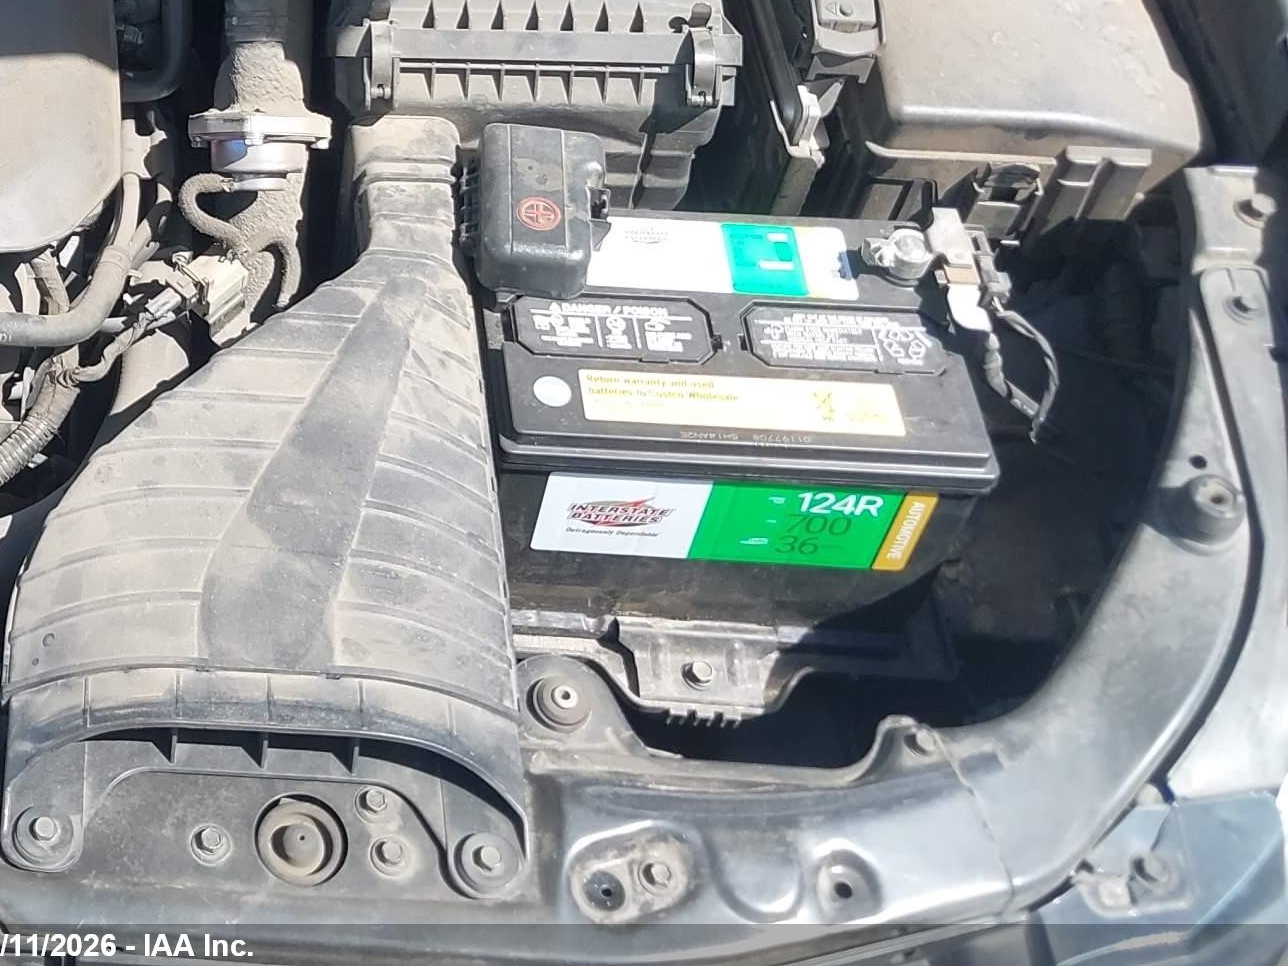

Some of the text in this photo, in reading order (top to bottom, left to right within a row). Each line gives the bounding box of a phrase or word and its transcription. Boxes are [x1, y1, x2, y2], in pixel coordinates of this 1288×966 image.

[586, 375, 620, 384] Return
[623, 377, 666, 388] warranty
[569, 503, 674, 517] INTERSTATE
[798, 492, 884, 517] 124R
[567, 512, 662, 523] BATTERIES
[786, 513, 853, 536] 700
[565, 527, 613, 535] Outrageously
[886, 501, 927, 561] AUTOMOTIVE
[775, 535, 819, 555] 36
